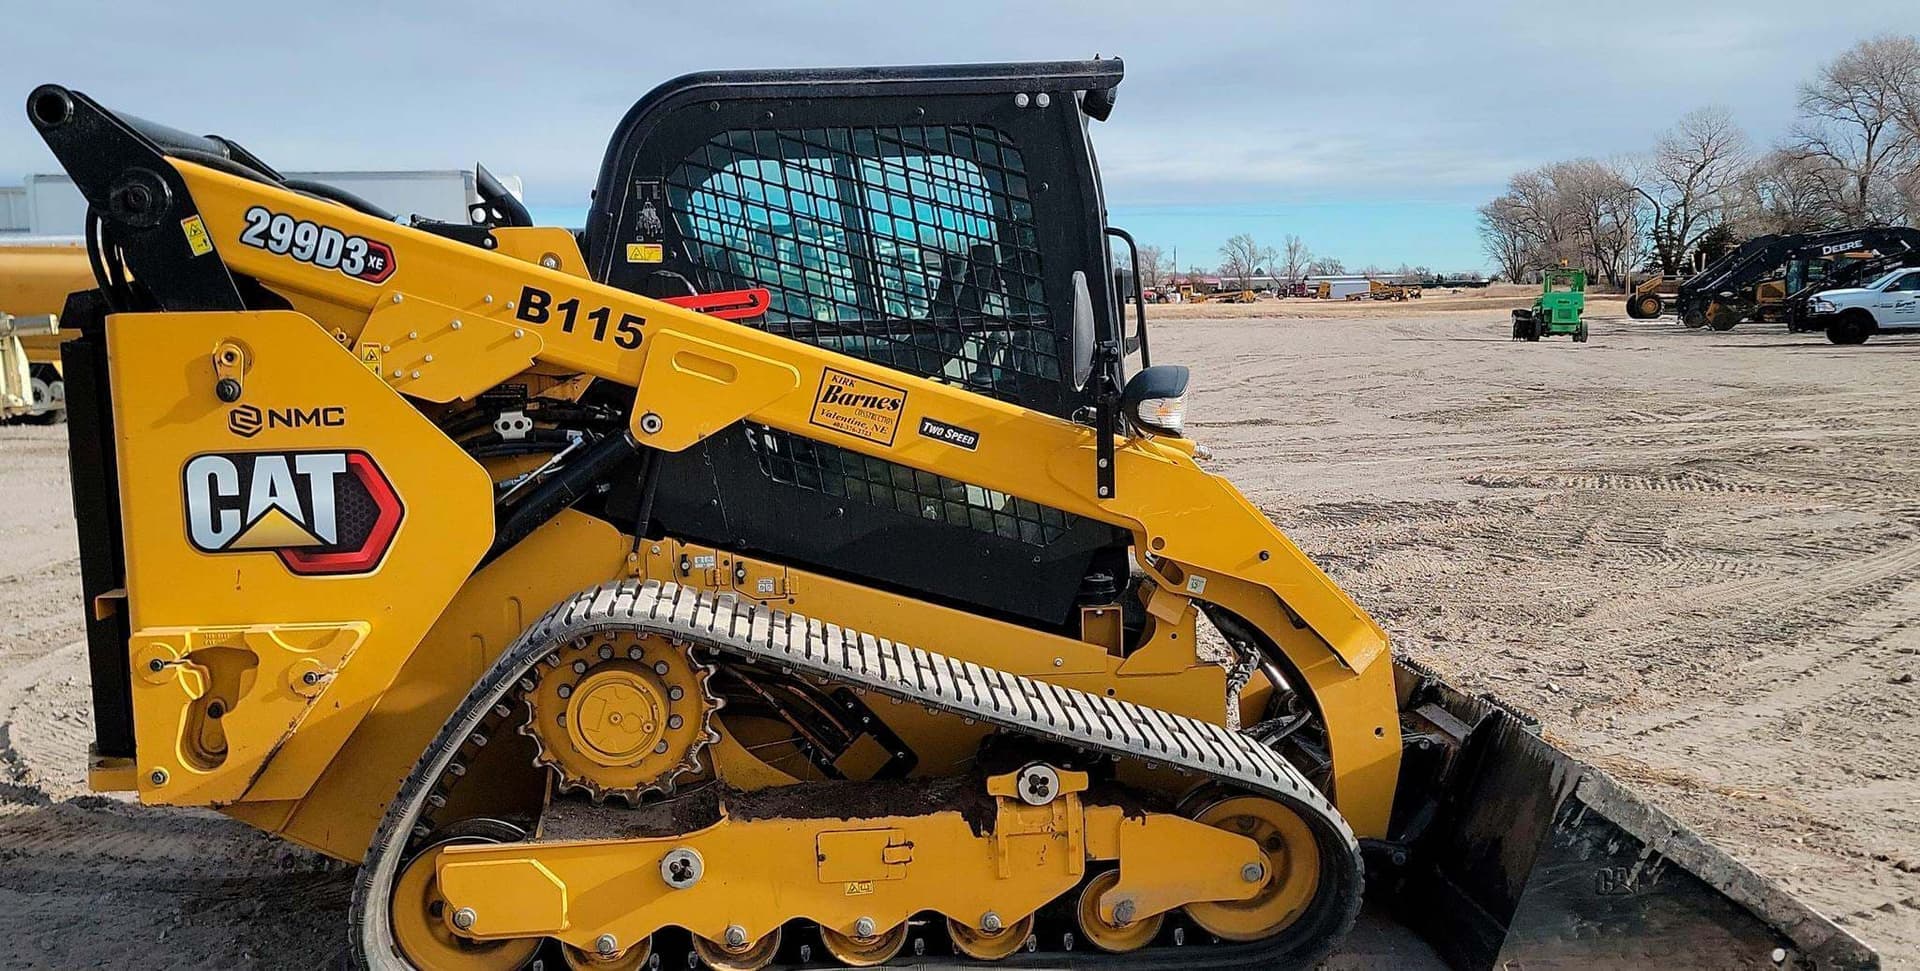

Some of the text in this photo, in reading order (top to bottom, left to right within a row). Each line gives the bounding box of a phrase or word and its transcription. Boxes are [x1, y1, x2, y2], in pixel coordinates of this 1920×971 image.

[240, 207, 385, 276] 299D3 XE
[1822, 240, 1864, 255] DEERE
[516, 285, 647, 350] B115
[832, 374, 857, 388] KIRK
[820, 384, 902, 411] Barnes
[268, 407, 345, 428] NMC
[820, 408, 889, 435] Valentine, NE
[186, 453, 347, 550] CAT
